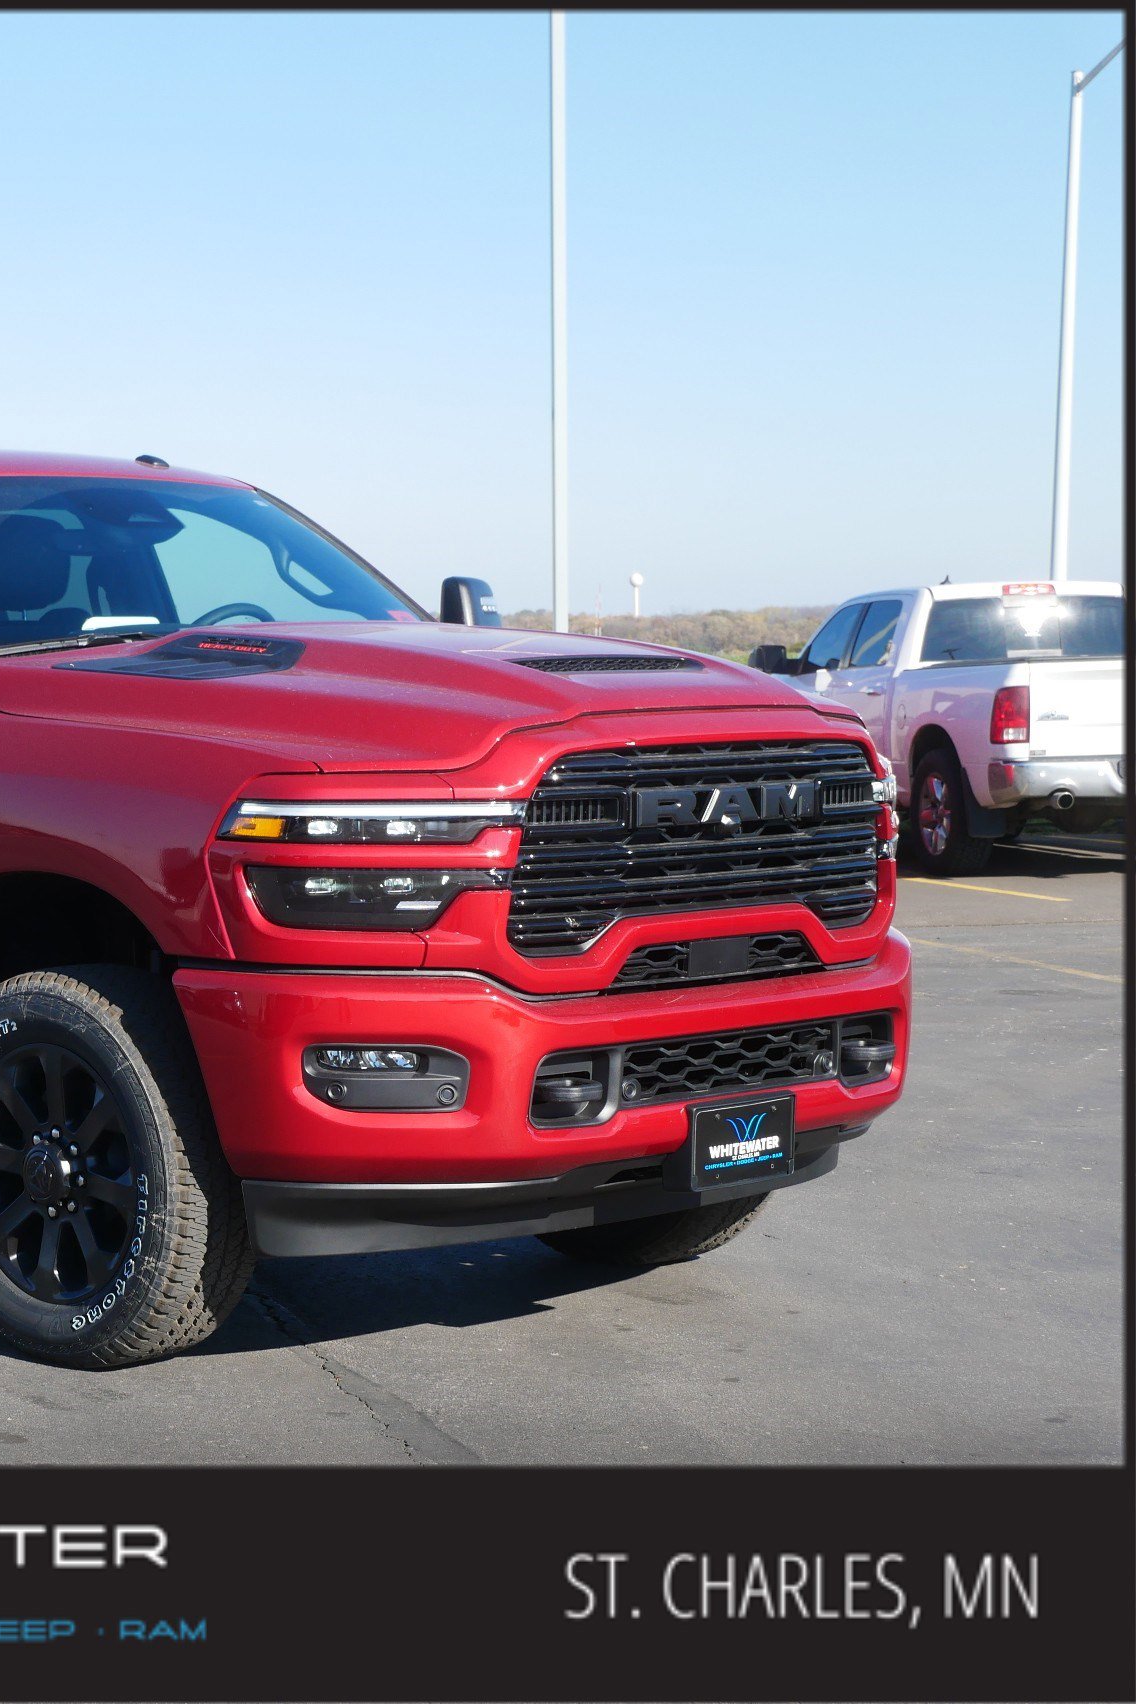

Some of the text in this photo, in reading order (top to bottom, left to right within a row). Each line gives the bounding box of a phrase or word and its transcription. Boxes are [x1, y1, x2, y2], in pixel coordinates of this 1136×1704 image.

[636, 783, 815, 828] RAM
[709, 1135, 780, 1159] WHITEWATER
[704, 1161, 733, 1170] CHRYSLER
